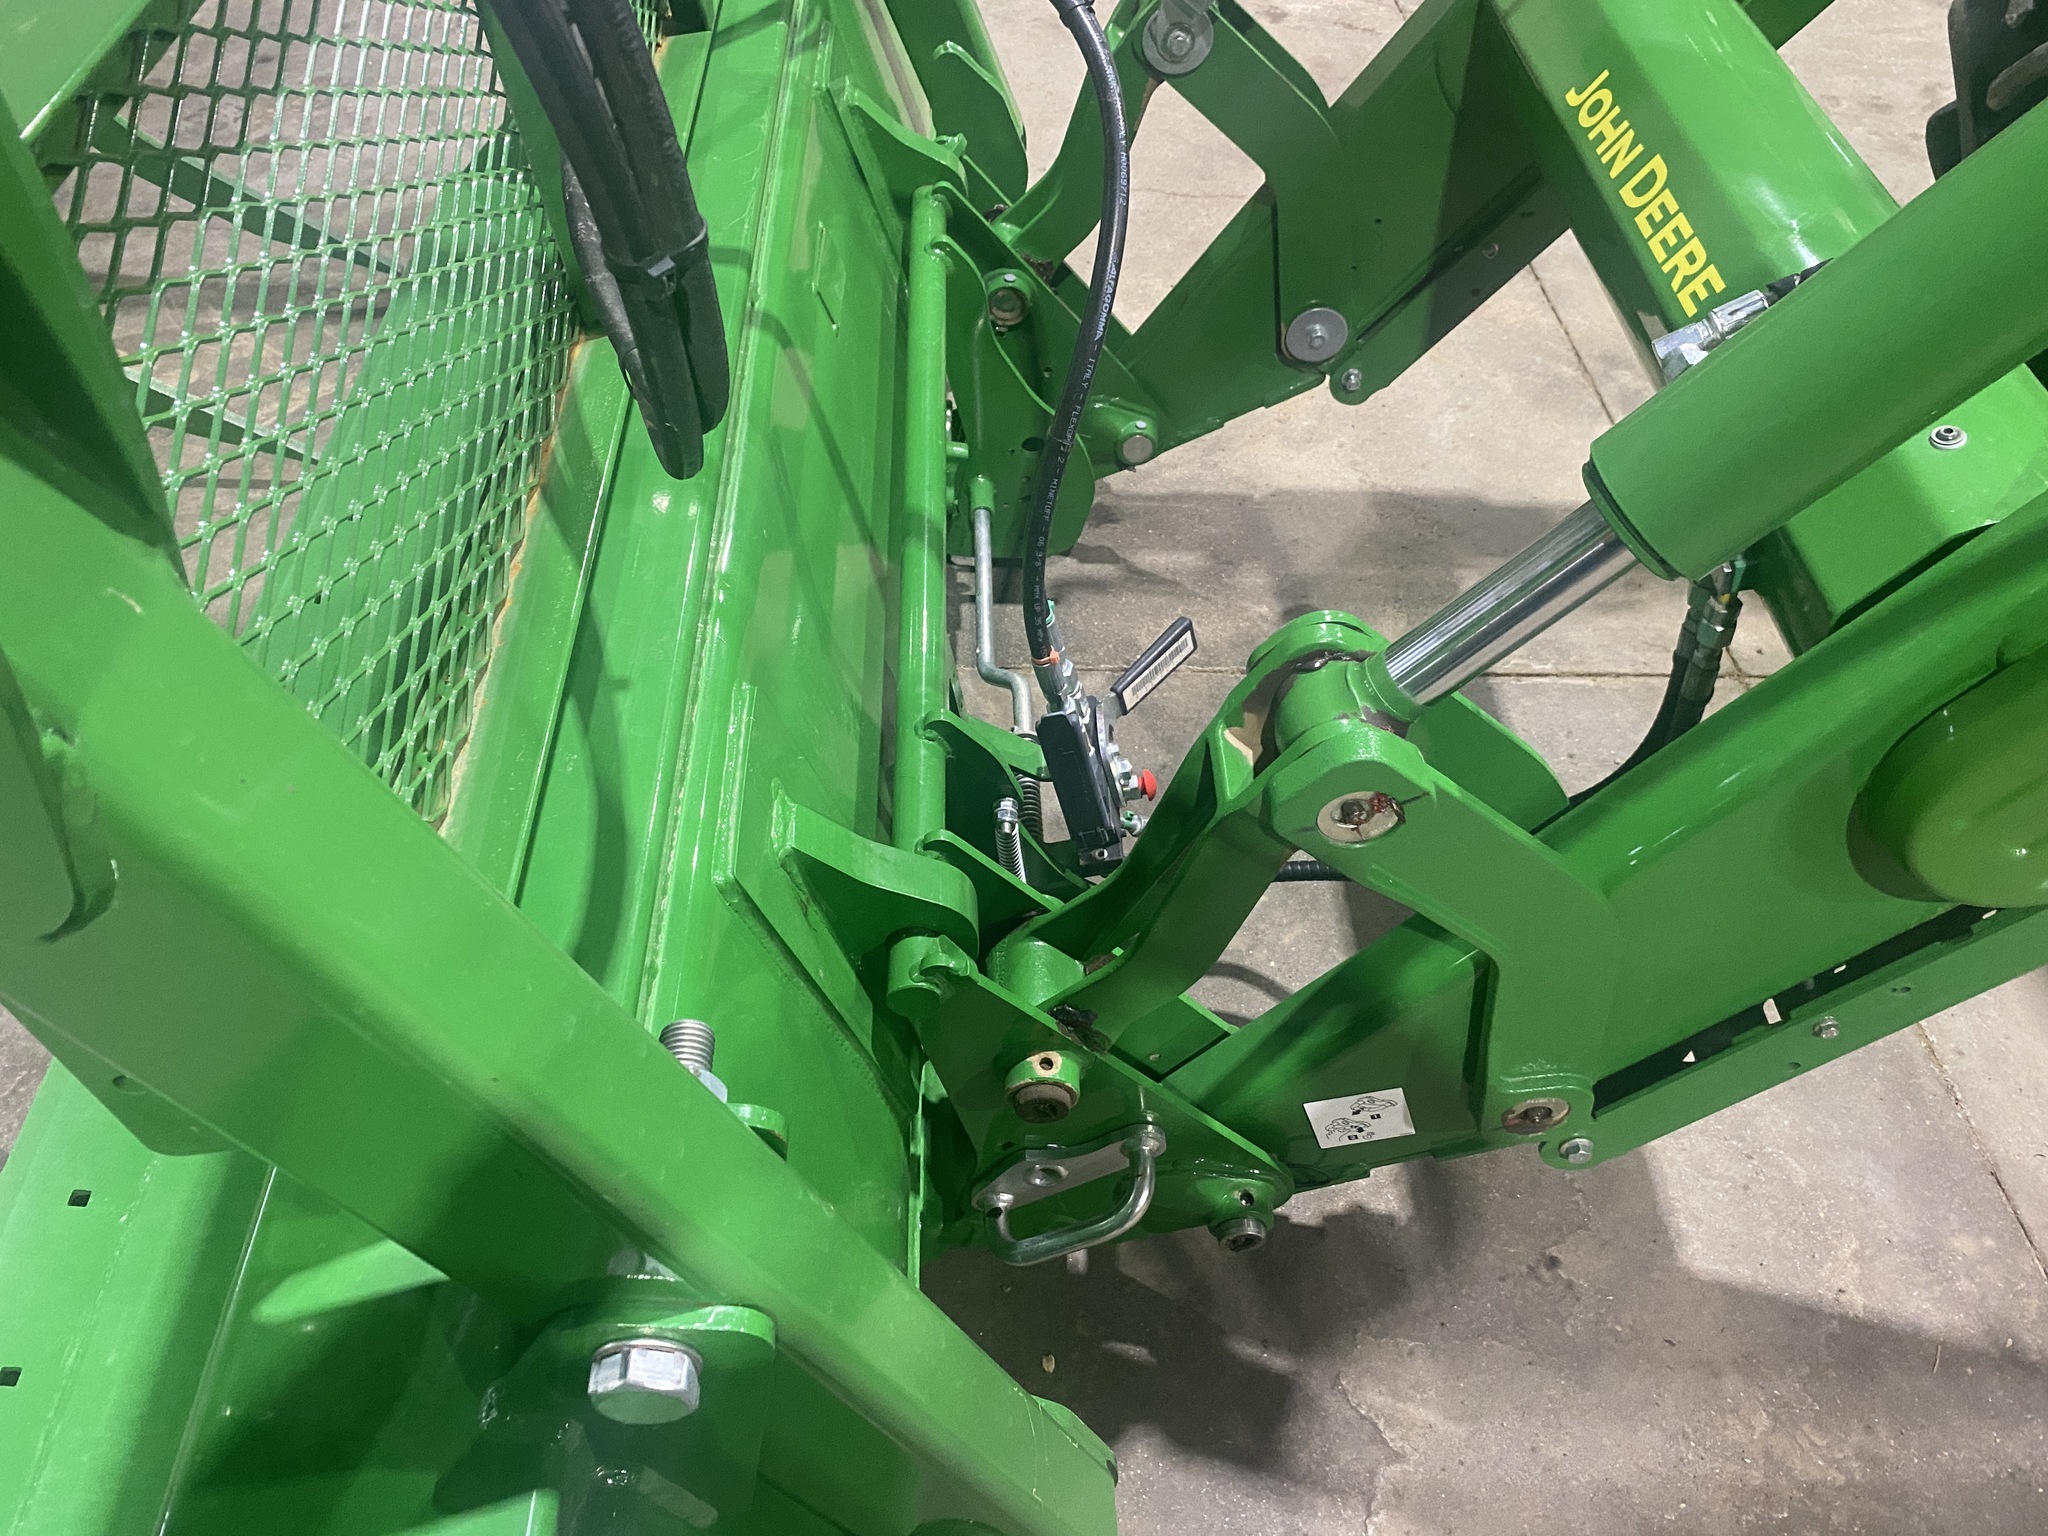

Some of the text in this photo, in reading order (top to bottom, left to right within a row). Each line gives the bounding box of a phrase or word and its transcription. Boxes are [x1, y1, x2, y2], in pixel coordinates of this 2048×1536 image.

[1565, 70, 1726, 318] JOHN DEERE
[1094, 261, 1117, 341] ALFAGOMMA
[1081, 358, 1096, 389] ITALY
